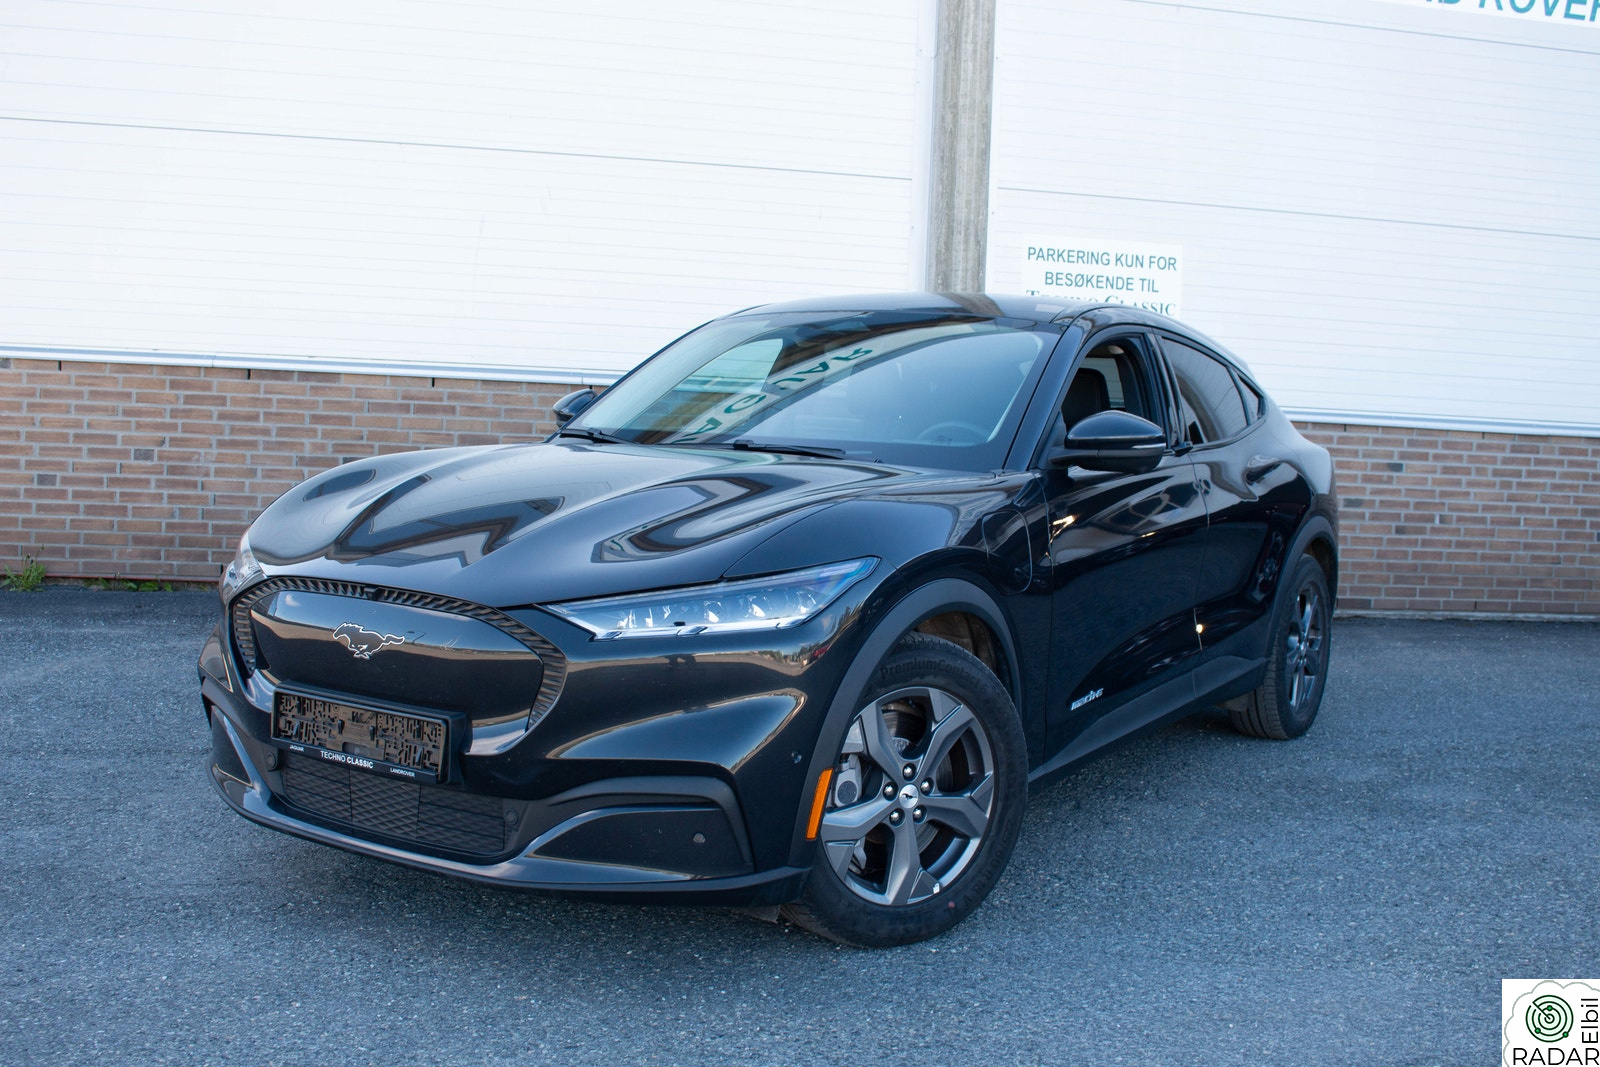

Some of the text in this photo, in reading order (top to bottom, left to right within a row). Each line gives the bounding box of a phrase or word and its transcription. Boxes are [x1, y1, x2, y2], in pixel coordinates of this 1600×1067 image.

[1027, 246, 1177, 271] PARKERING KUN FOR
[1044, 271, 1159, 293] BESØKENDE TIL
[1104, 295, 1176, 316] SSIC
[320, 750, 374, 769] TECHNO CLASSIC
